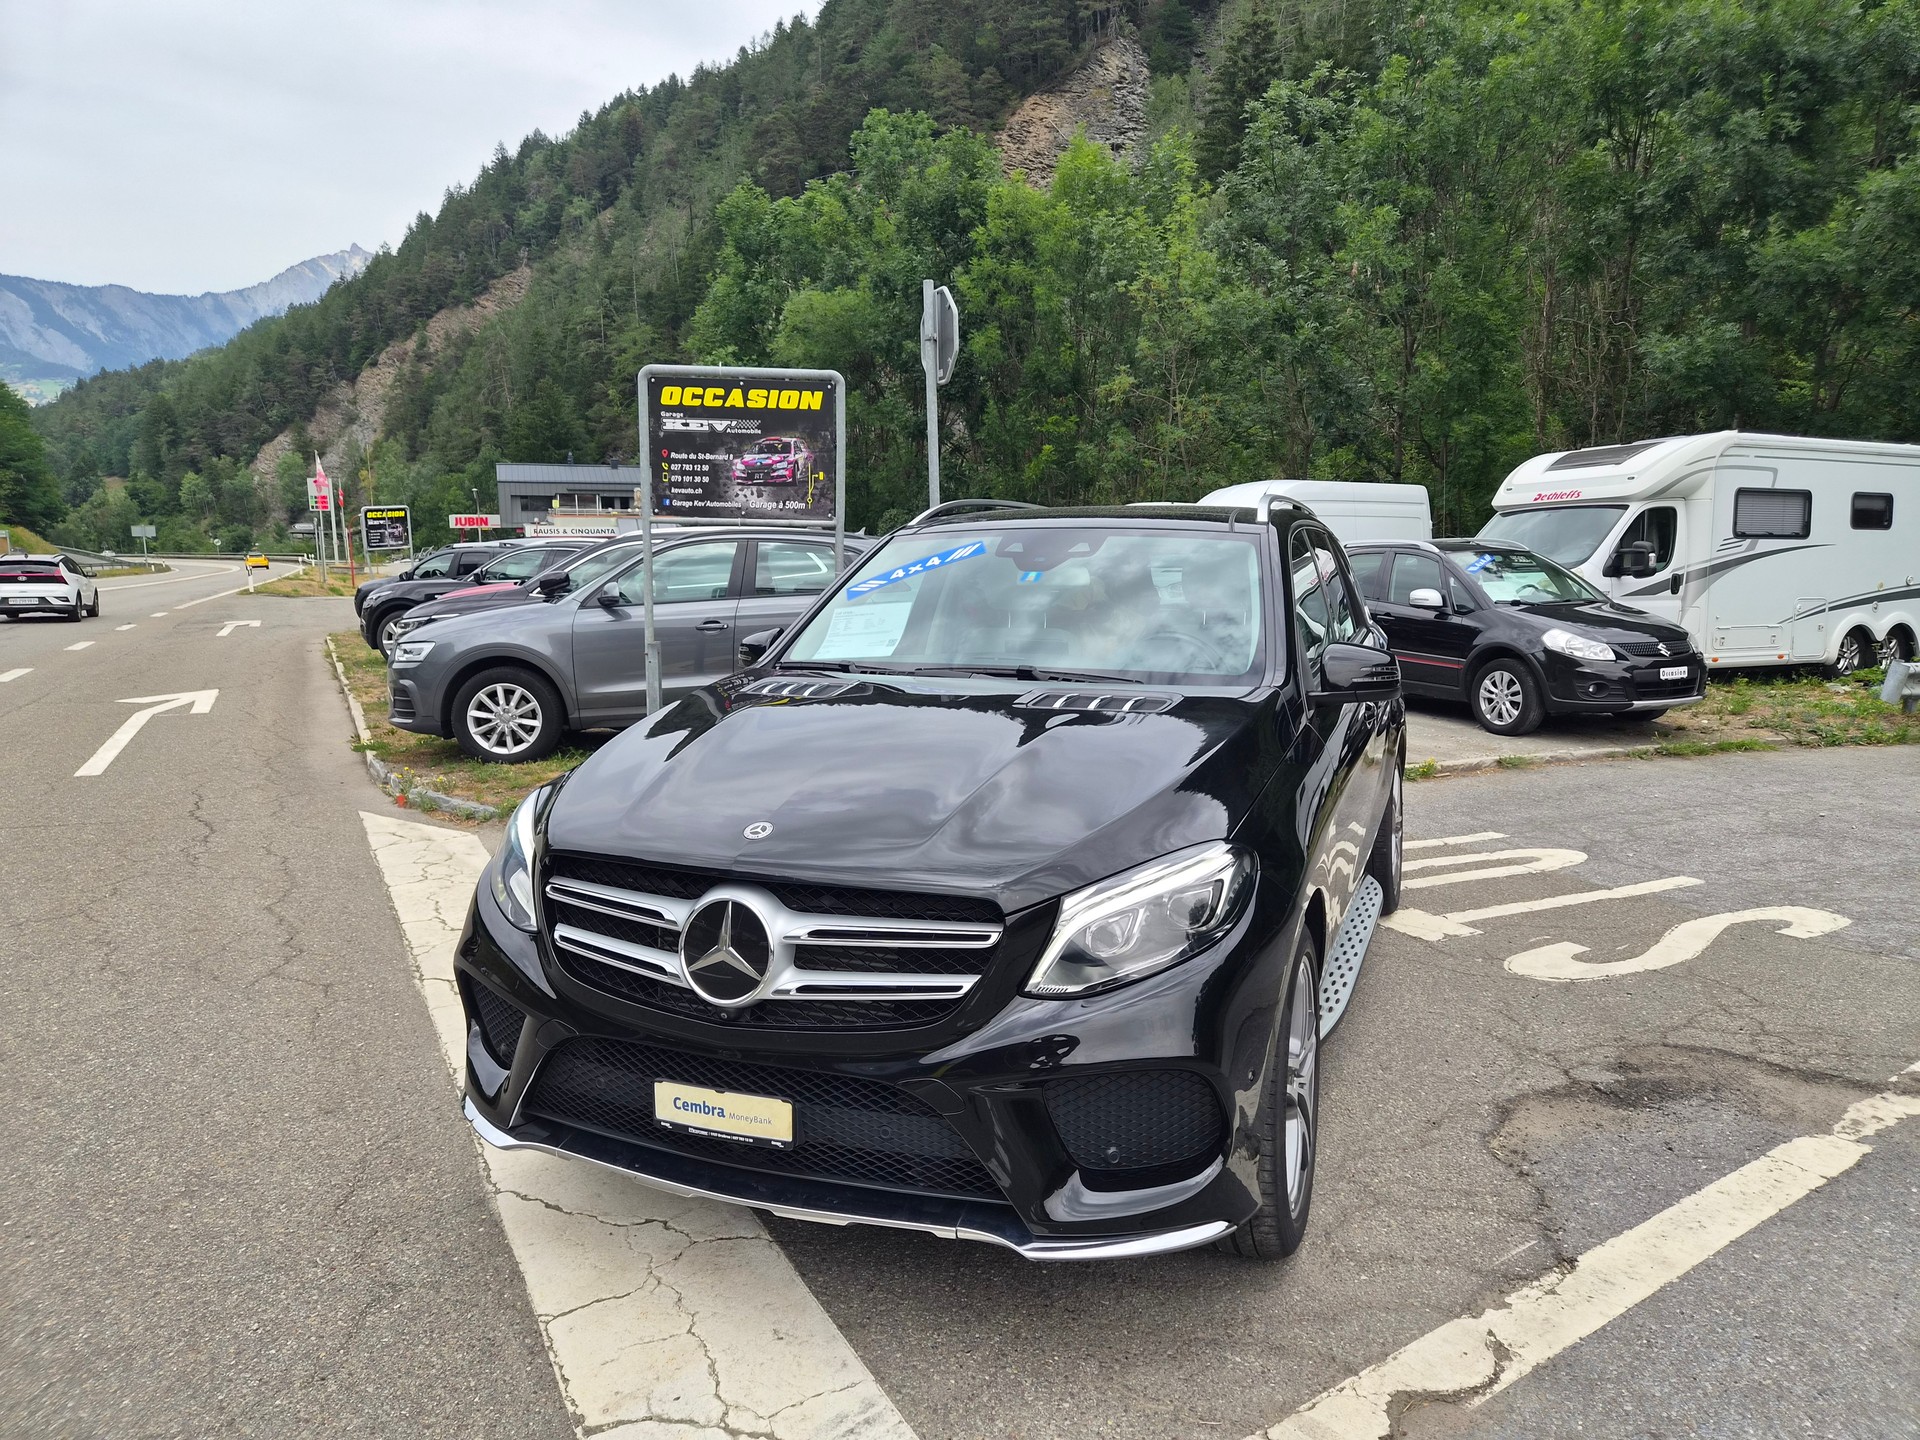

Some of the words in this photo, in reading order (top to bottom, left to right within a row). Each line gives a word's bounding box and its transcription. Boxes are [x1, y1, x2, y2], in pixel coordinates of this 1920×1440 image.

[660, 386, 823, 410] OCCASION
[698, 452, 729, 460] St-Bernard
[694, 500, 742, 508] Kev'Automobiles
[749, 500, 777, 511] Garage
[778, 501, 784, 509] à
[785, 500, 806, 509] 500m
[455, 517, 489, 526] JUBIN
[673, 1096, 726, 1118] Cembra
[729, 1112, 773, 1125] MoneyBank
